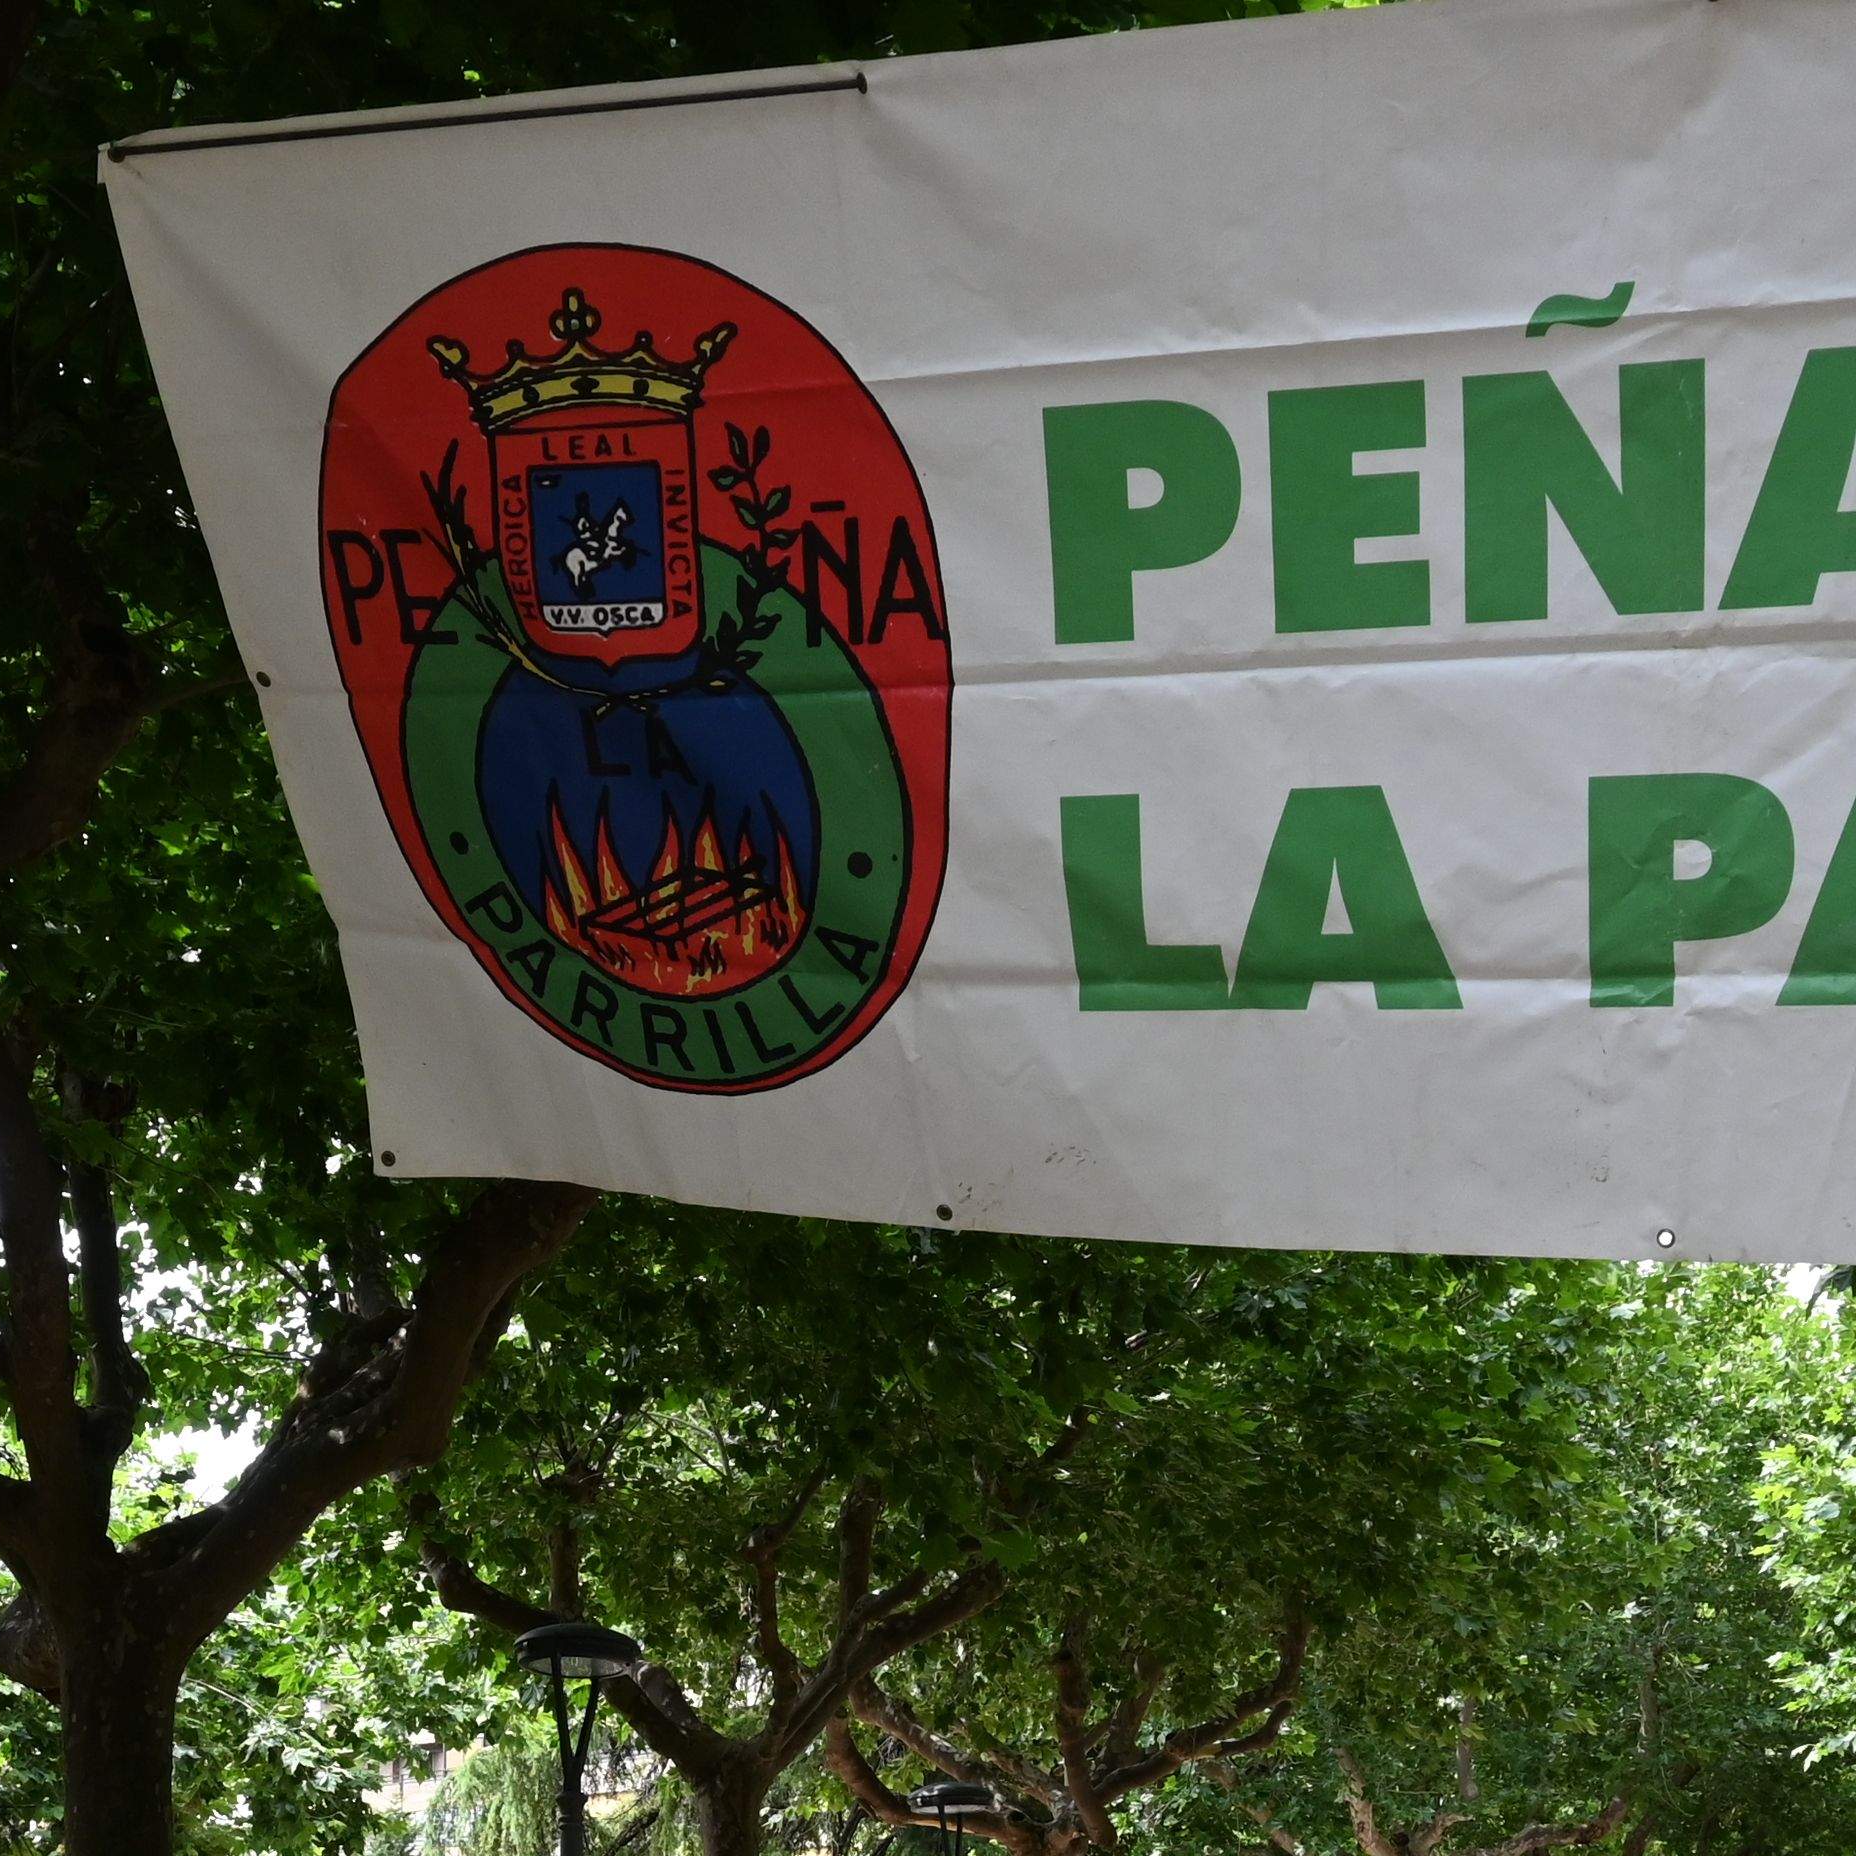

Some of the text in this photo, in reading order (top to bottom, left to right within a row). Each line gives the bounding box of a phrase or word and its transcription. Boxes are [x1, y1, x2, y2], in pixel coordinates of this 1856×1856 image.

[541, 433, 636, 461] LEAL
[502, 474, 540, 621] HEROICA
[593, 606, 655, 626] OSCA
[665, 469, 693, 619] INVICTA
[580, 702, 699, 787] LA
[1060, 785, 1464, 1012] LA
[463, 880, 880, 1075] PARRILLA
